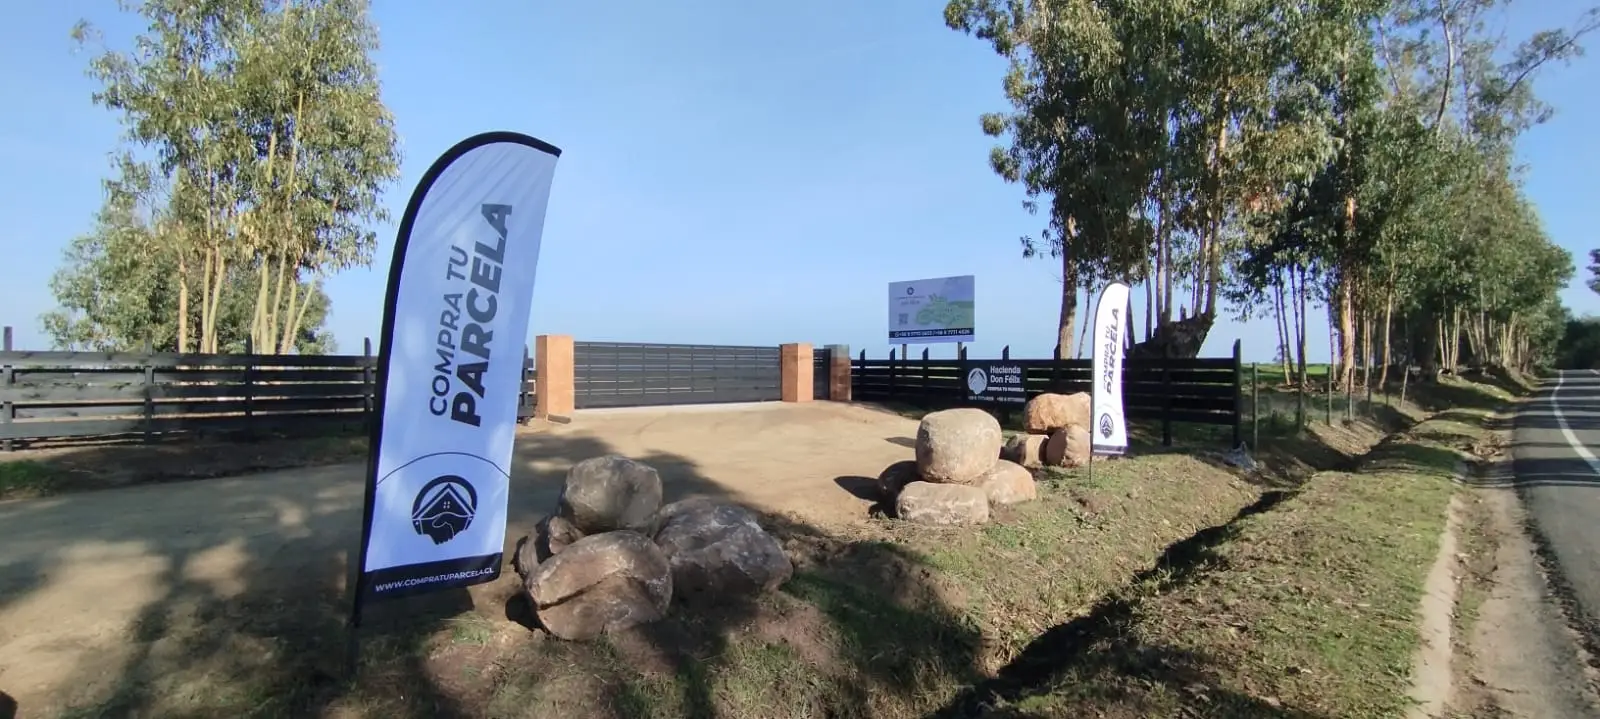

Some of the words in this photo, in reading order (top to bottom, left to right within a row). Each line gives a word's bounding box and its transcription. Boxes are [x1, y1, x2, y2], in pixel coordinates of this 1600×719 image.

[429, 293, 463, 416] COMPRA
[446, 245, 469, 281] TU
[451, 203, 513, 427] PARCELA
[990, 365, 1021, 374] Hacienda
[990, 375, 1004, 384] Don
[1106, 308, 1119, 395] PARCELA
[375, 567, 495, 592] WWW.COMPRATUPARCELA.CL
